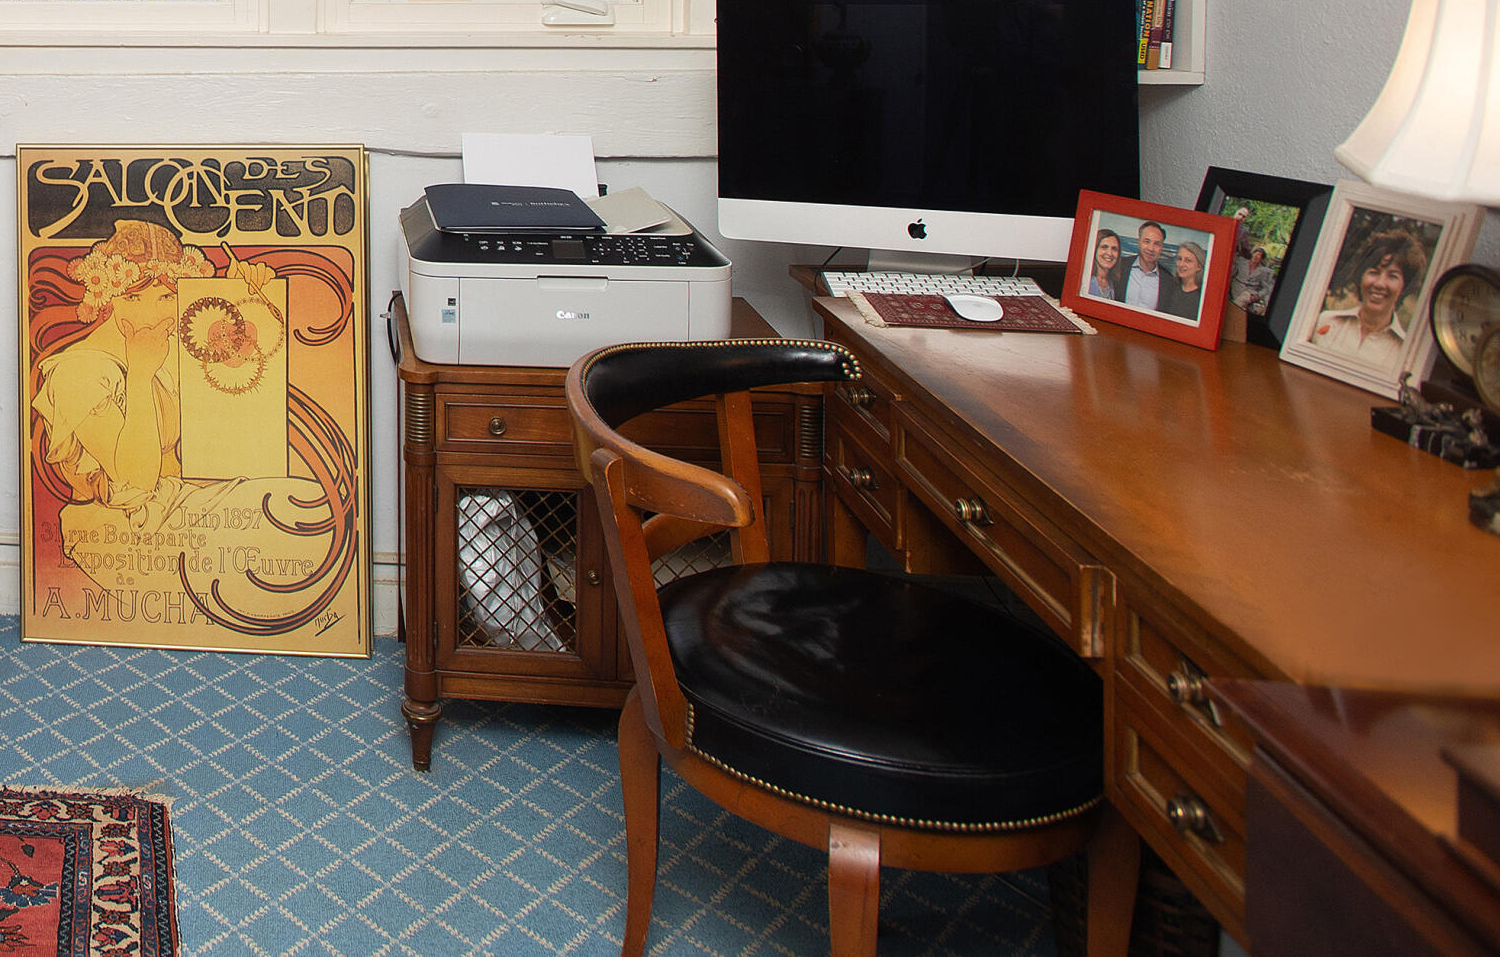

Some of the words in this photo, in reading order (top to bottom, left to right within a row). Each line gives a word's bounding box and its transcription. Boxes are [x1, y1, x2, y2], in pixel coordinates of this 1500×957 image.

[1143, 0, 1155, 40] NATION
[35, 157, 232, 239] SALON
[242, 156, 332, 191] DES
[556, 310, 590, 320] Canon
[168, 505, 221, 531] Juin
[223, 507, 264, 531] 1897
[67, 528, 100, 544] rue
[103, 523, 207, 551] Bonaparte
[57, 544, 180, 577] Exposition
[188, 550, 213, 574] de
[115, 572, 136, 586] de
